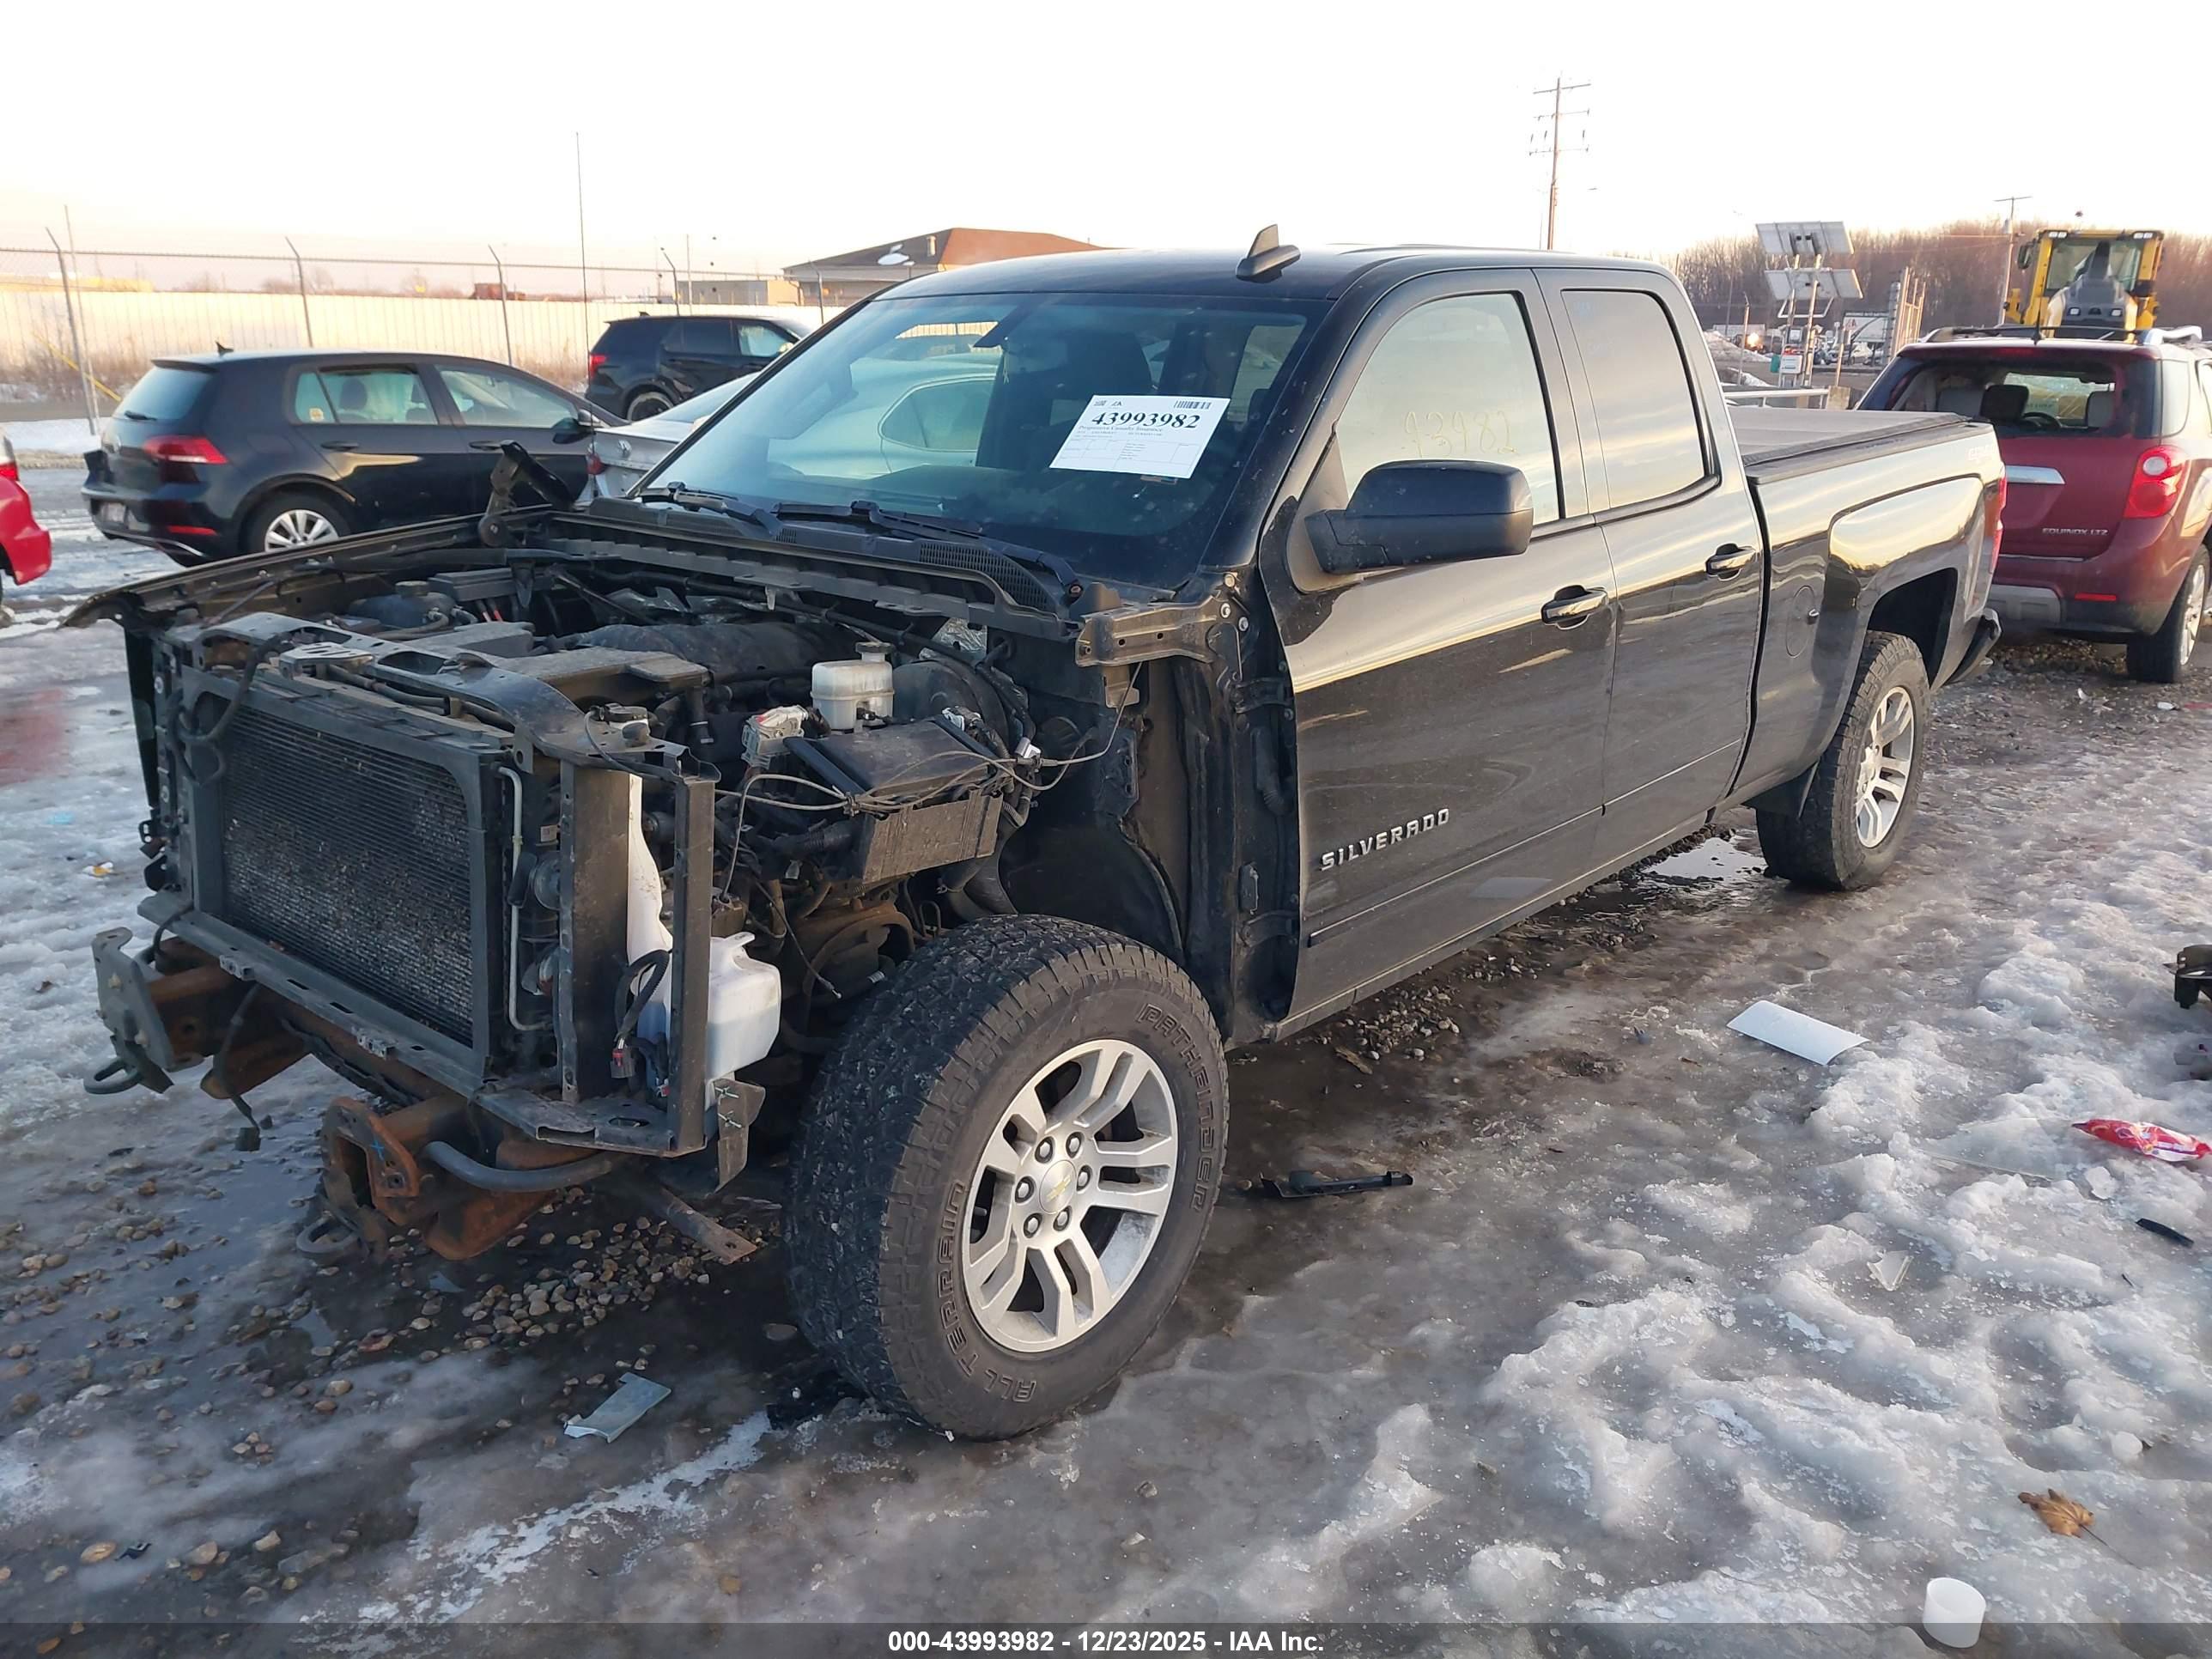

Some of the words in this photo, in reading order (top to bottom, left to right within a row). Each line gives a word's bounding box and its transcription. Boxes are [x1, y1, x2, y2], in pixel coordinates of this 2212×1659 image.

[1091, 411, 1201, 428] 43993982
[2042, 527, 2088, 536] EQUINOX
[1321, 808, 1449, 871] SILVERADO
[1136, 1002, 1215, 1212] PATHFINDER
[937, 1179, 980, 1377] TERRAIN
[984, 1369, 1037, 1402] ALL
